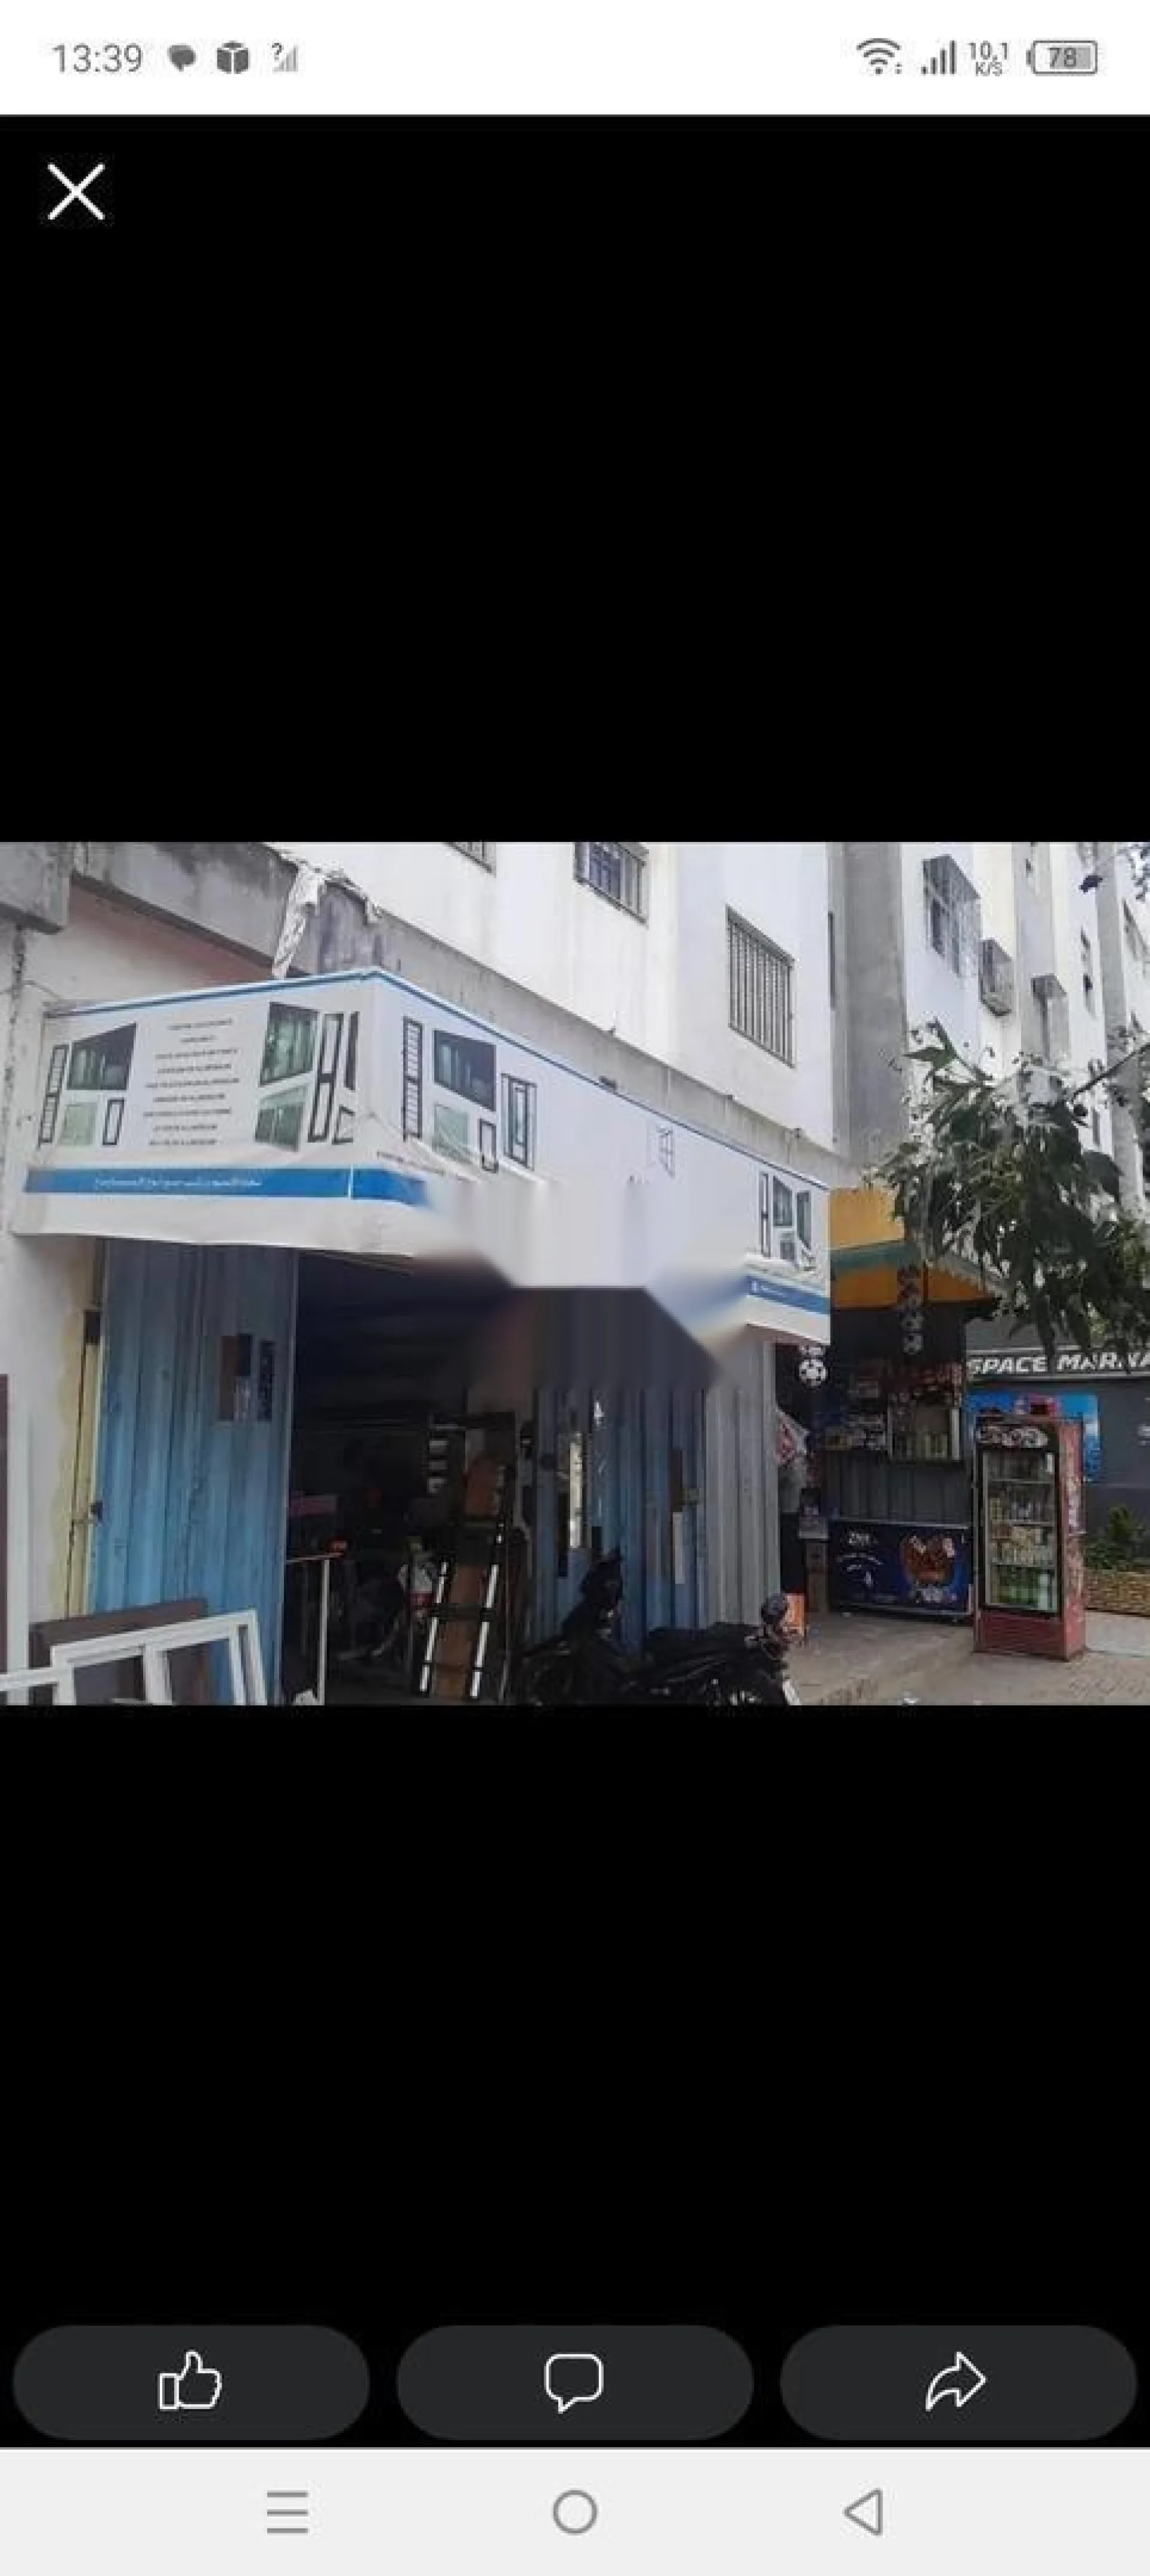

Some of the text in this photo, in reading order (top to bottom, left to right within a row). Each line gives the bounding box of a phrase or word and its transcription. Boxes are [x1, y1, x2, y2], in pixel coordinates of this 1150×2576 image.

[52, 42, 142, 72] 13:39
[1046, 47, 1078, 68] 78
[975, 61, 1004, 77] K/S
